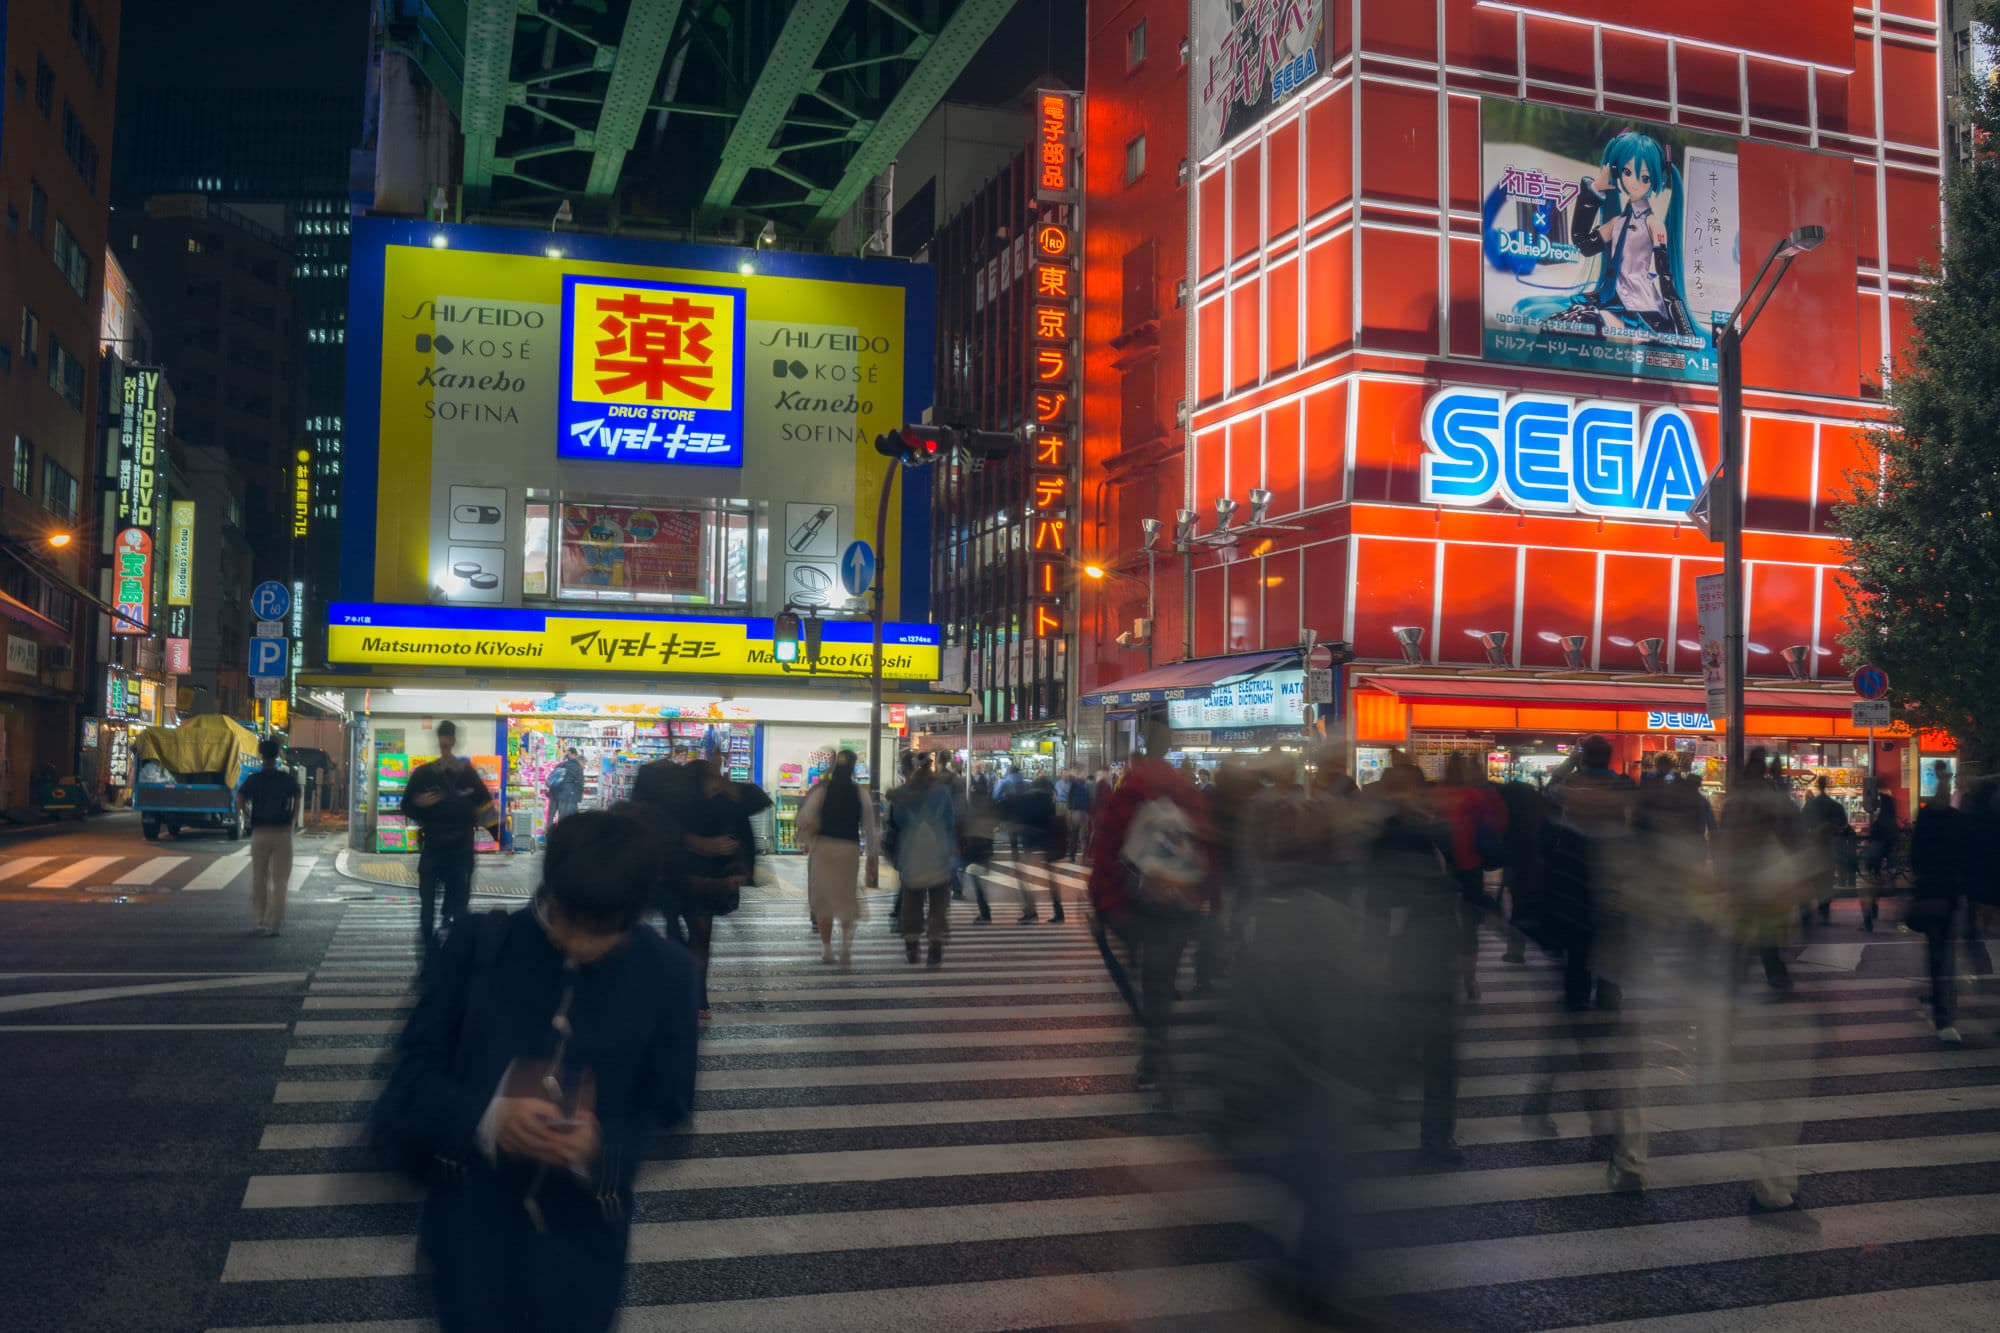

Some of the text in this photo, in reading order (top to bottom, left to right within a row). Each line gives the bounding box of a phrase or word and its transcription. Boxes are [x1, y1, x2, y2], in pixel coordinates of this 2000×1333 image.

[1272, 48, 1317, 102] SEGA
[1042, 96, 1065, 189] 電子部品
[1500, 166, 1580, 210] 初音ミク
[402, 300, 544, 328] SHISEIDO
[462, 338, 531, 360] KOSÉ
[594, 293, 715, 402] 薬
[759, 327, 890, 354] SHISEIDO
[417, 366, 526, 393] Kanebo
[815, 363, 878, 383] KOSÉ
[424, 400, 519, 424] SOFINA
[608, 406, 696, 421] DRUG STORE
[774, 390, 873, 415] Kanebo
[570, 418, 731, 459] マツモトキヨシ
[782, 423, 868, 445] SOFINA
[138, 372, 158, 525] VIDEO DVD
[1036, 266, 1067, 637] 東京ラジオデパート
[1428, 391, 1707, 515] SEGA
[178, 528, 189, 598] mouse computer
[260, 590, 276, 615] P
[258, 641, 281, 673] P
[361, 637, 543, 657] Matsumoto KiYoshi
[570, 629, 721, 665] マツモトキヨシ
[1131, 691, 1150, 702] CASIO
[1164, 689, 1185, 700] CASIO
[1238, 680, 1273, 692] ELECTRICAL
[1280, 682, 1304, 695] WATC
[1101, 694, 1119, 705] CASIO
[1204, 694, 1233, 707] CAMERA
[1238, 692, 1273, 706] DICTIONARY
[1649, 711, 1714, 729] SEGA
